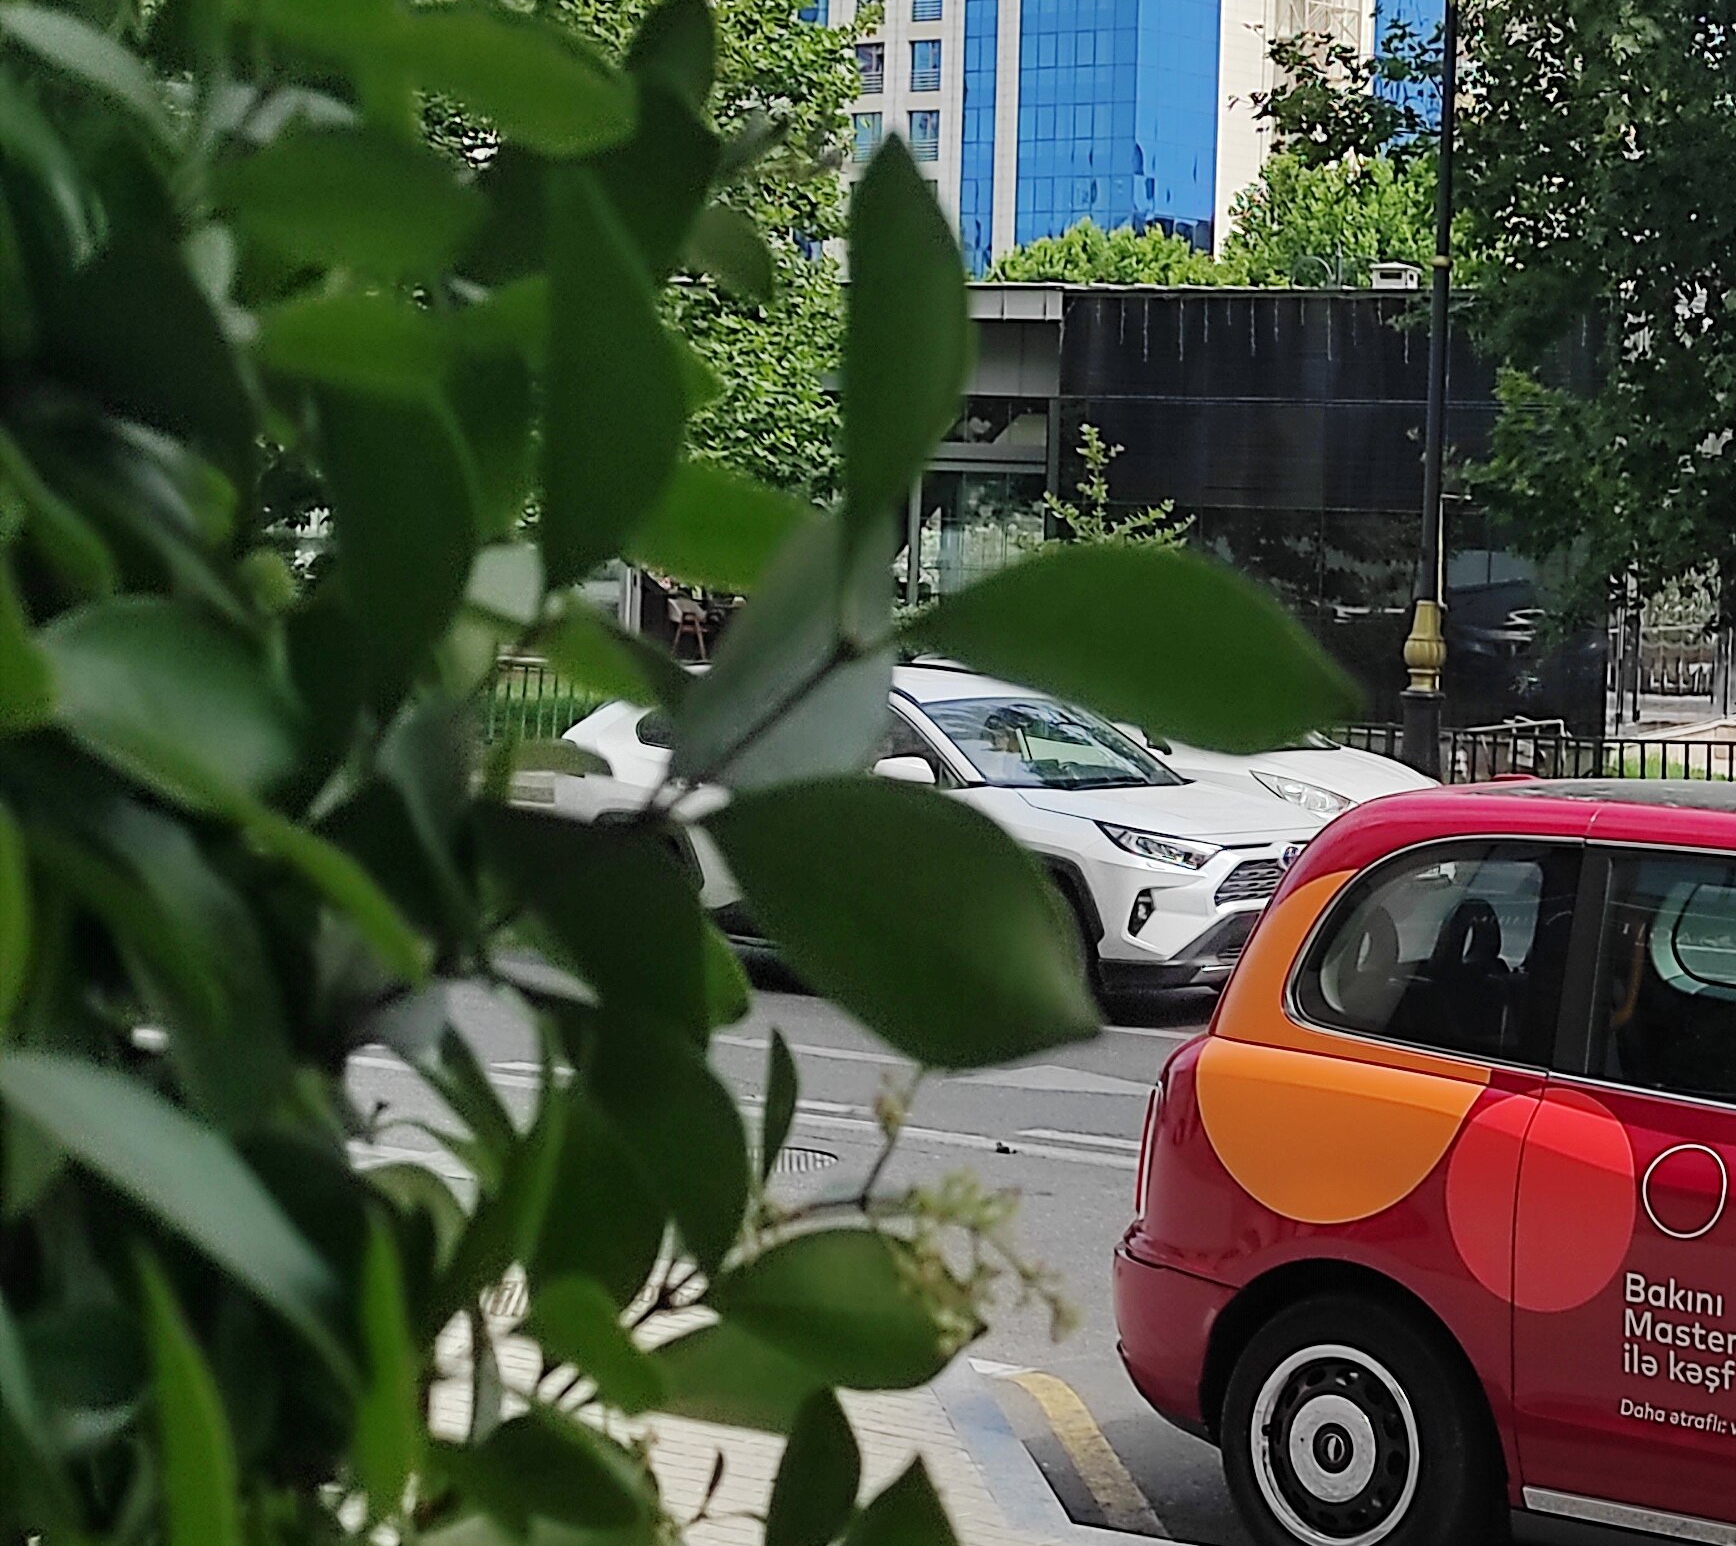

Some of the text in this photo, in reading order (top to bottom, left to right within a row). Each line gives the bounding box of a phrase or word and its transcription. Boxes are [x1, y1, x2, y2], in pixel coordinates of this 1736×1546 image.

[1624, 1271, 1724, 1318] Bakını
[1622, 1342, 1659, 1378] ilə
[1668, 1348, 1736, 1395] kəşf
[1619, 1398, 1667, 1423] Daha
[1668, 1410, 1728, 1435] ətraflı:
